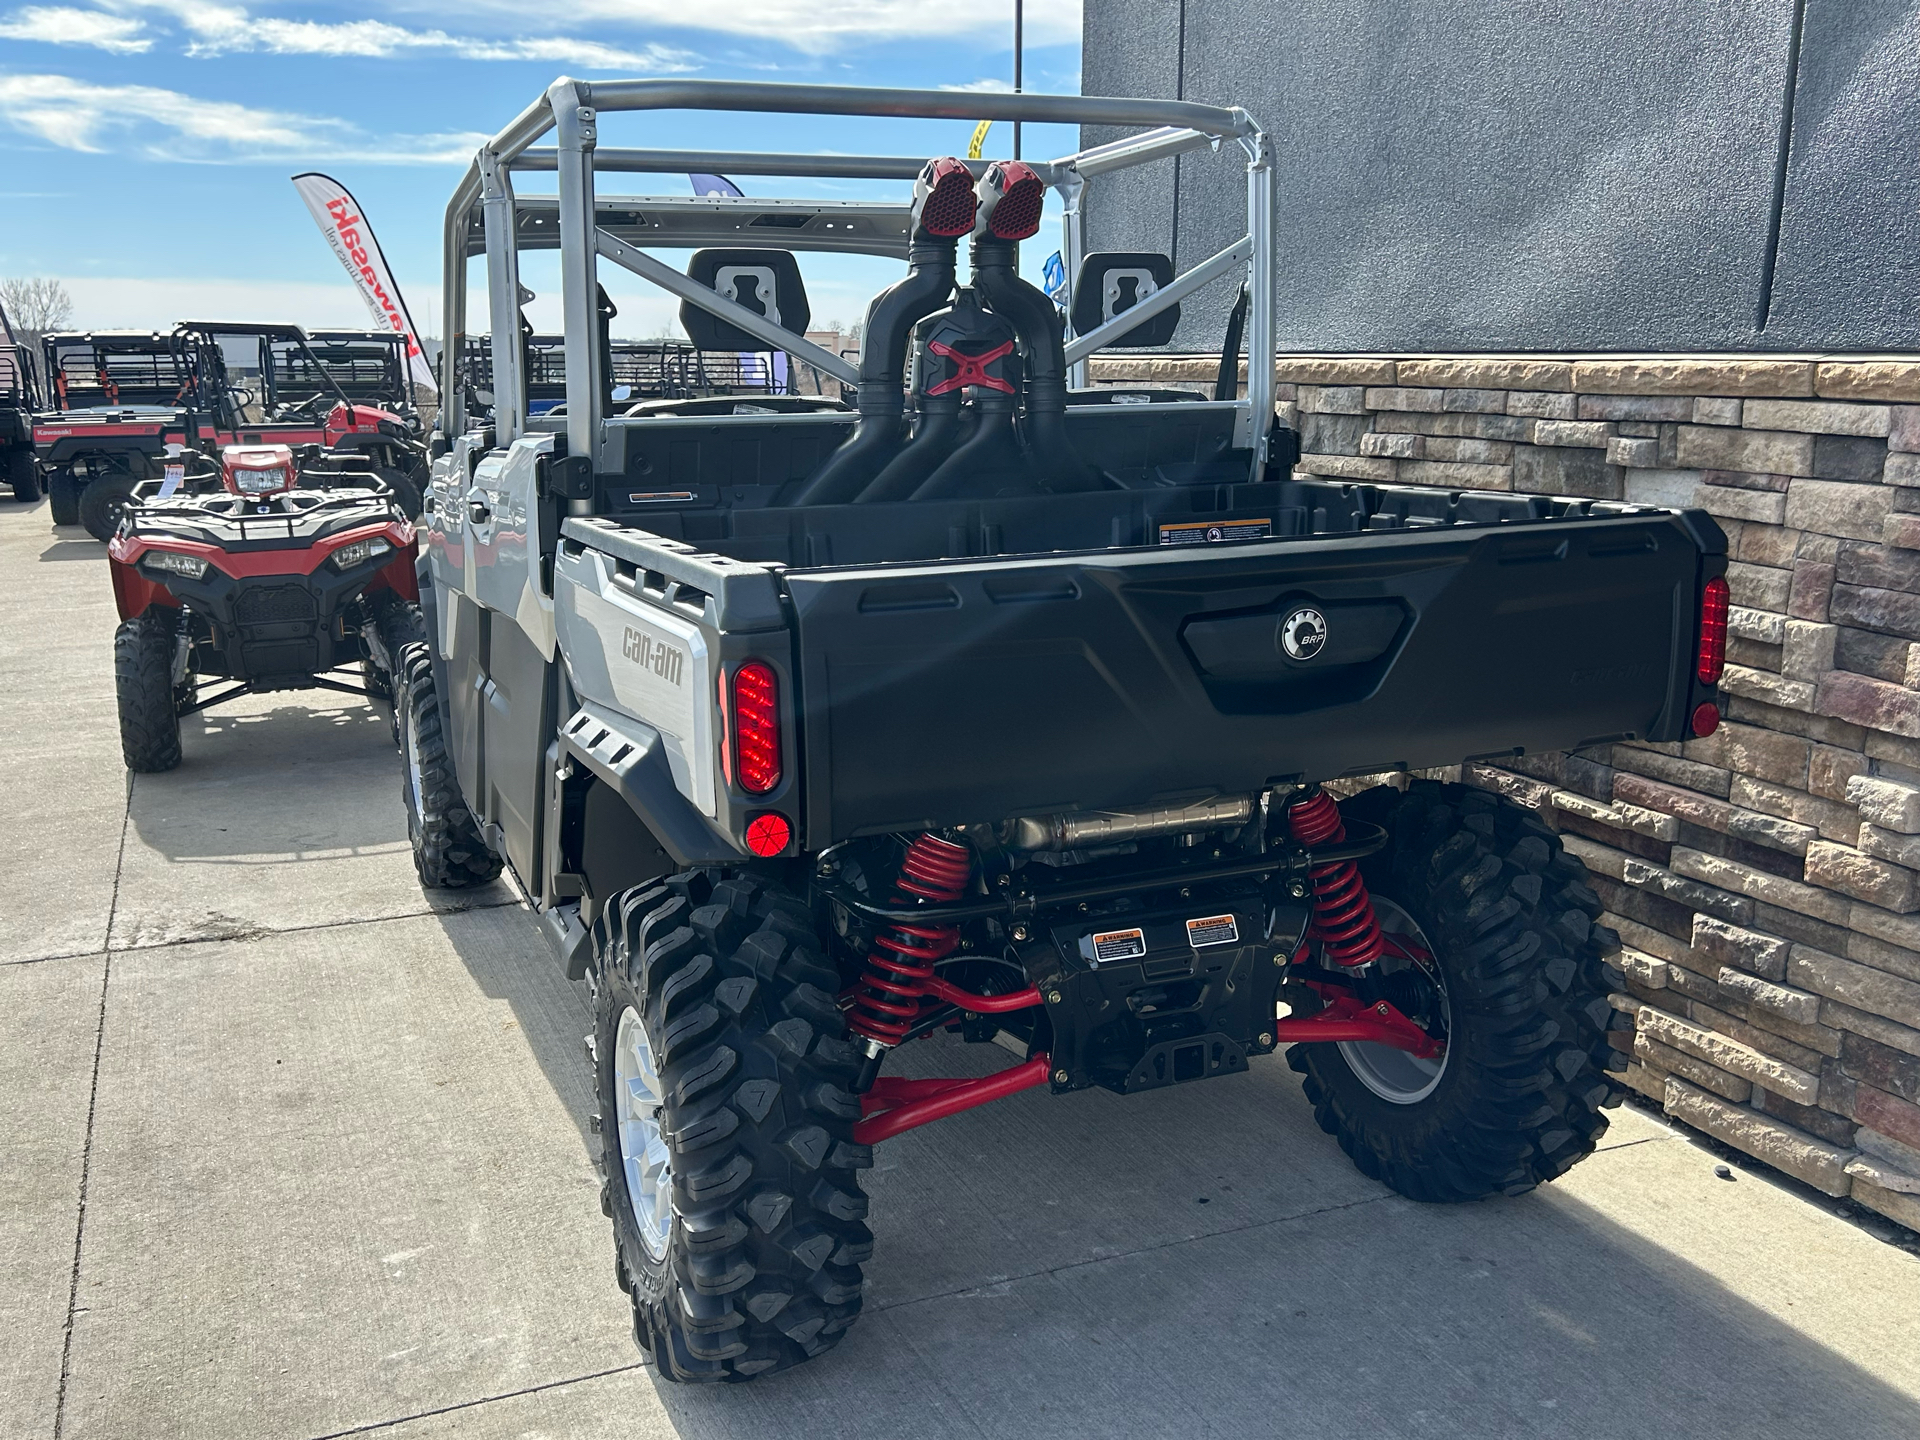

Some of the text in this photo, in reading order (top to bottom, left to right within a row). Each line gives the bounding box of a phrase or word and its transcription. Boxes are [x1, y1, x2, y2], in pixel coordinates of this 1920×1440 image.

[36, 428, 72, 436] Kawasaki
[1301, 634, 1324, 645] BRP
[622, 626, 683, 687] can-am
[1201, 918, 1227, 927] WARNING
[1107, 932, 1134, 941] WARNING
